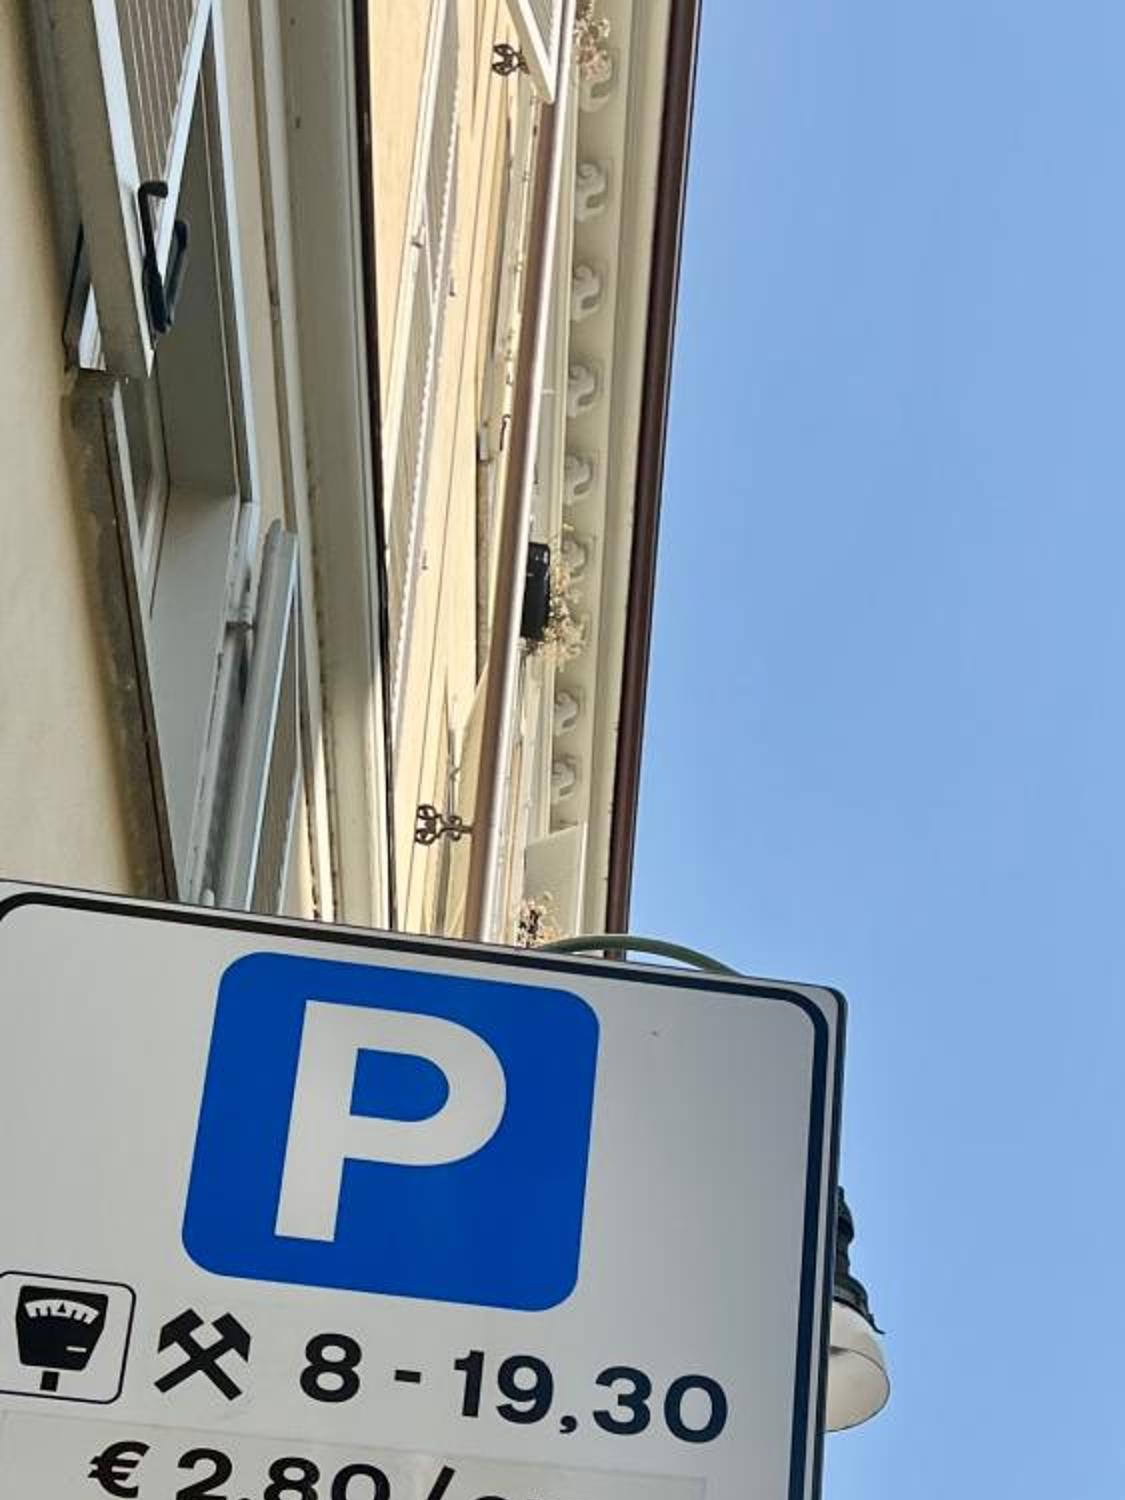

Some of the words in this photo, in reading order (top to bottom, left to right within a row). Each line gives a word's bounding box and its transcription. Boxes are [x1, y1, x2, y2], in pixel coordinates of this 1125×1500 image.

[274, 1000, 507, 1243] P
[300, 1333, 362, 1403] 8
[454, 1349, 728, 1444] 19,30
[88, 1441, 150, 1498] €
